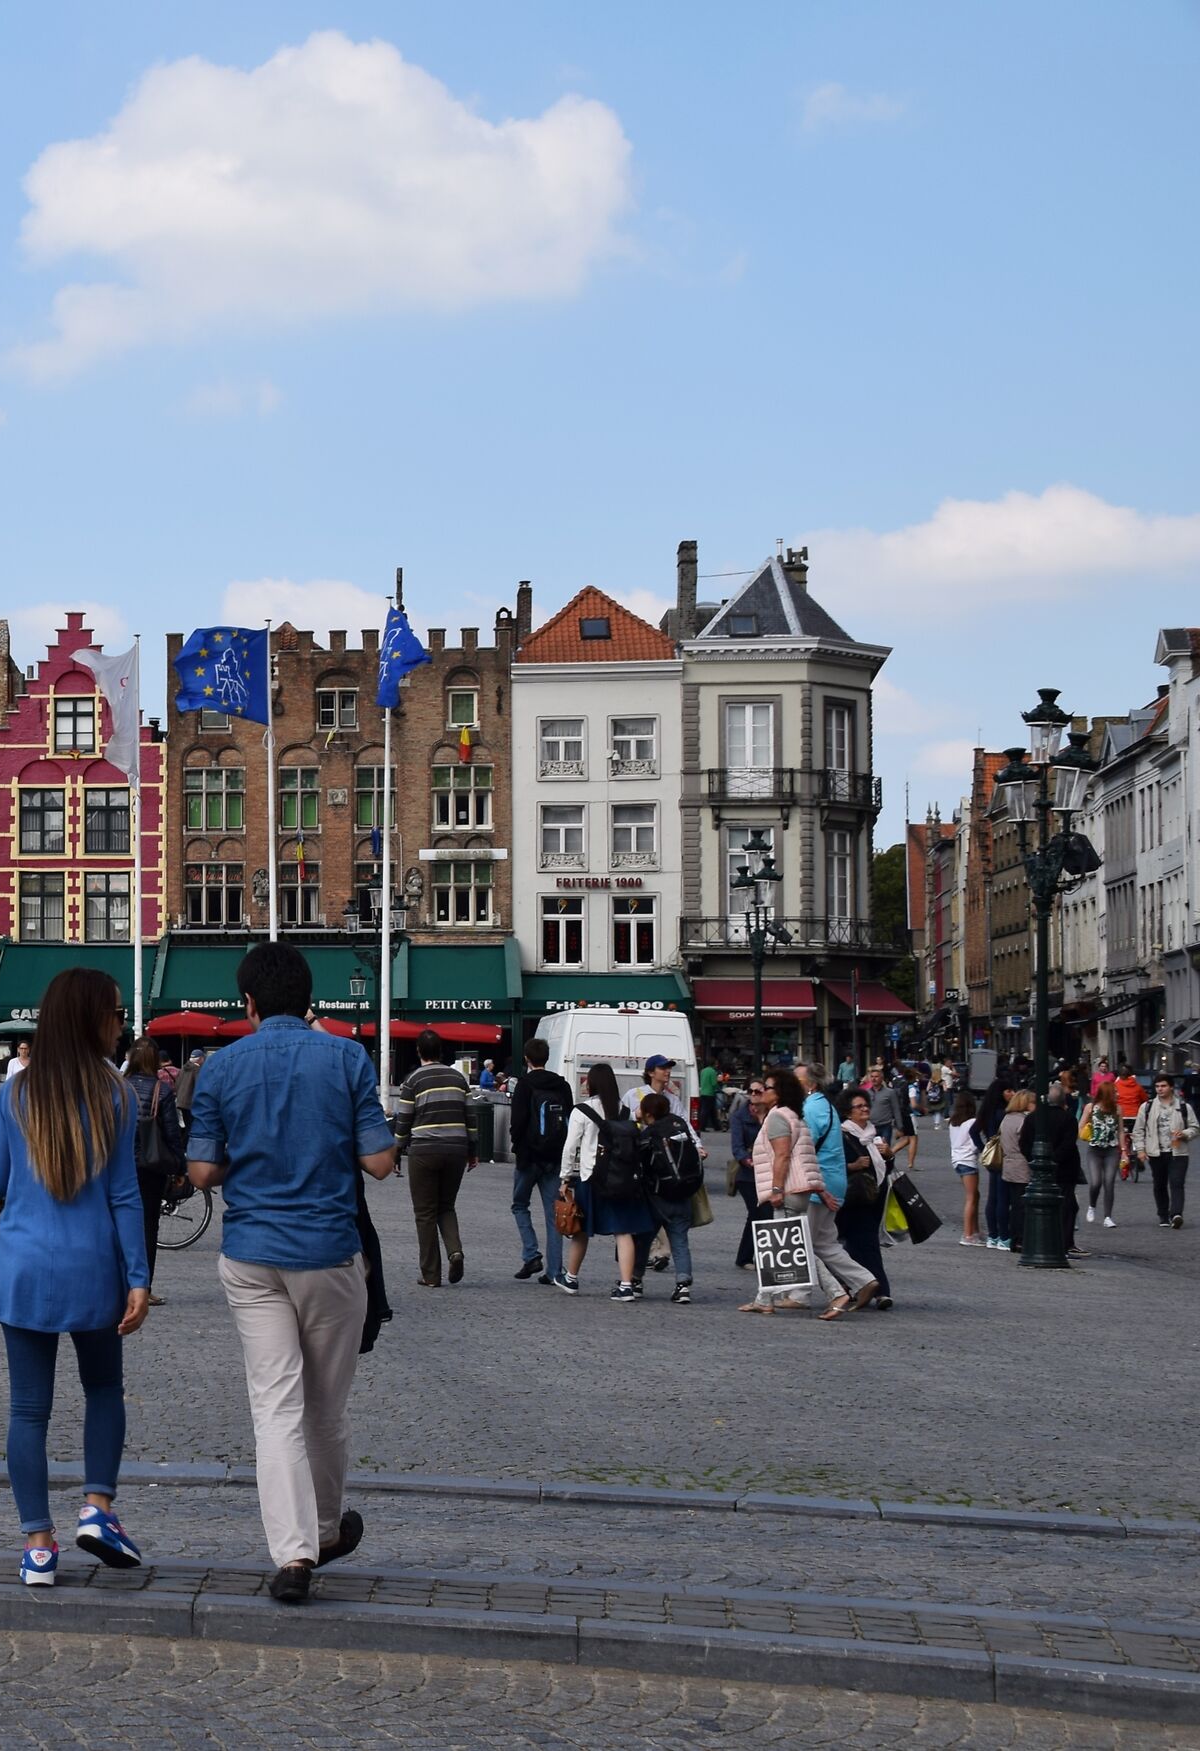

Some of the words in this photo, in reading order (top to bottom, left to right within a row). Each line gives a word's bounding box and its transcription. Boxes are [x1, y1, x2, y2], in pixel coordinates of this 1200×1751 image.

[556, 877, 611, 889] FRITERIE
[615, 877, 642, 888] 1900
[180, 999, 229, 1009] Brasserie
[425, 1000, 459, 1010] PETIT
[461, 1000, 492, 1010] CAFE
[546, 1001, 611, 1010] Fritrie
[617, 1001, 664, 1010] 1900
[757, 1225, 804, 1249] ava
[759, 1247, 808, 1270] nce
